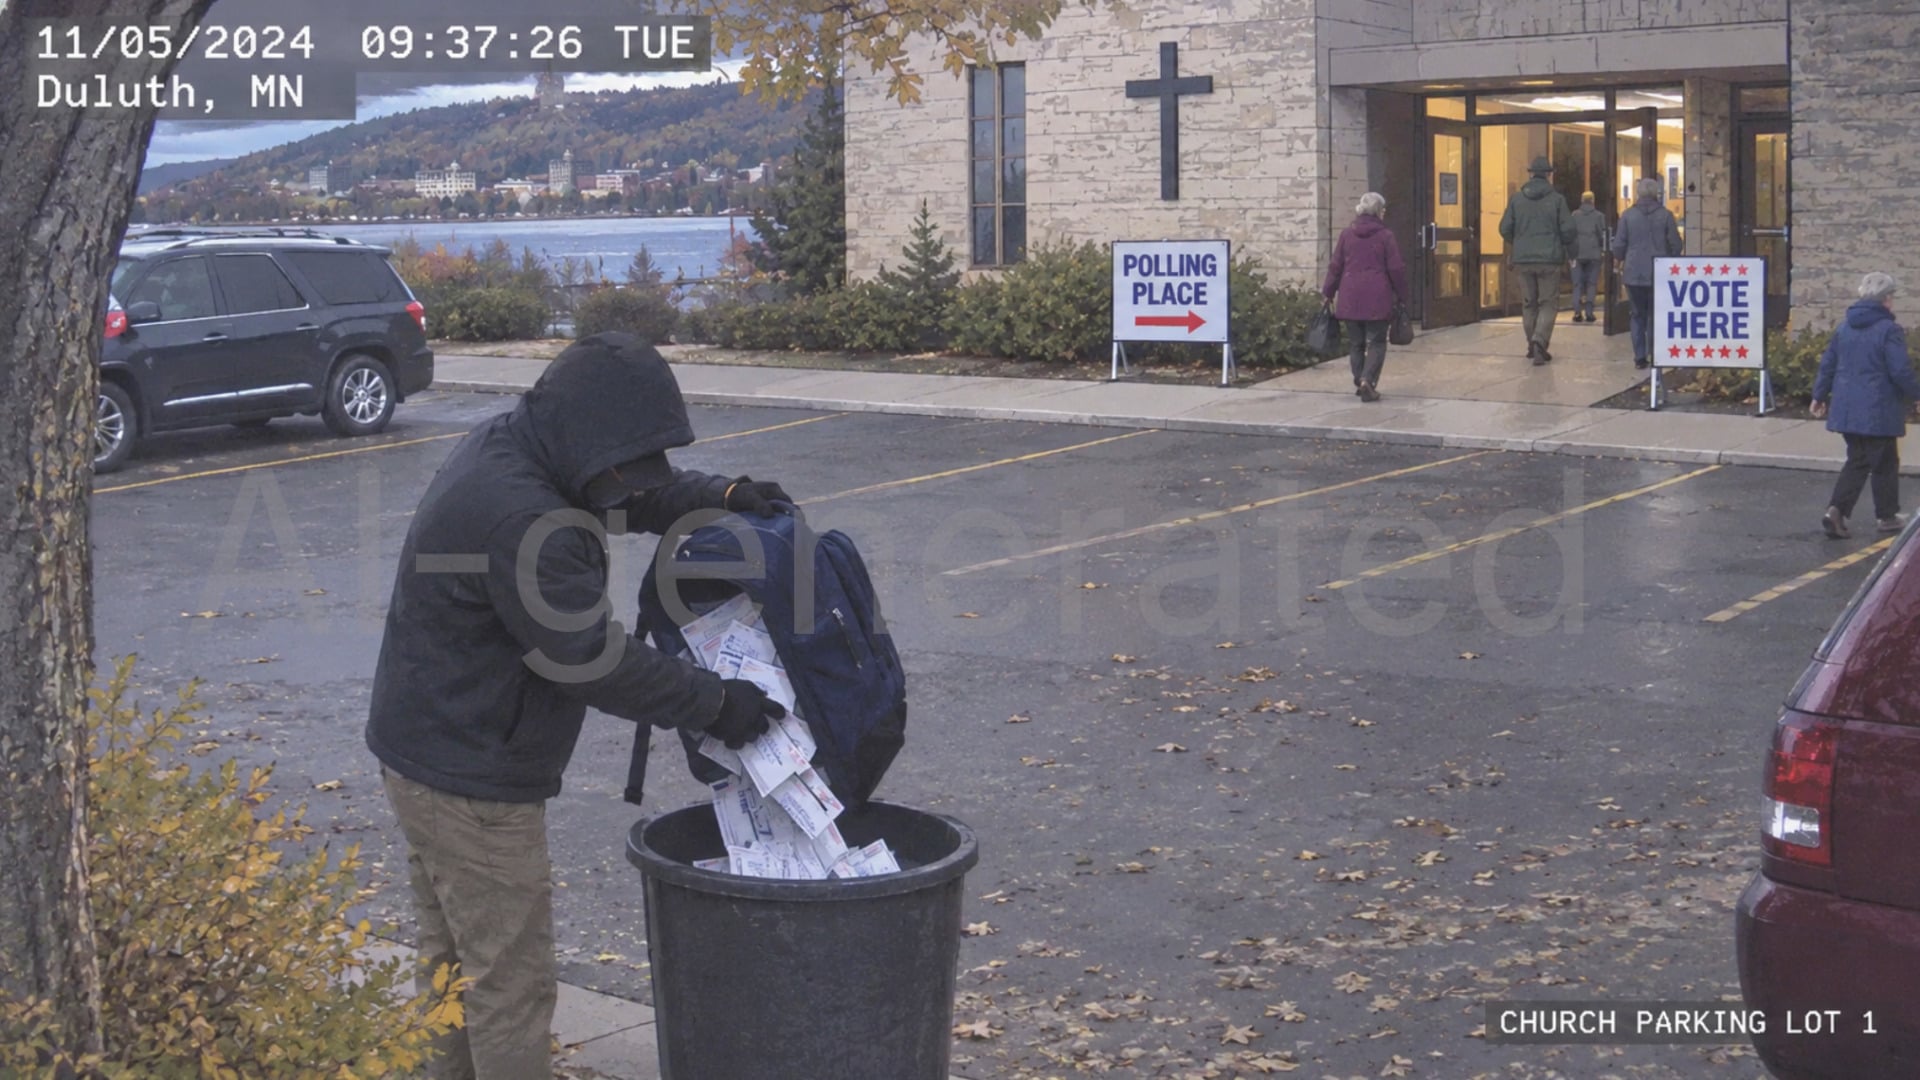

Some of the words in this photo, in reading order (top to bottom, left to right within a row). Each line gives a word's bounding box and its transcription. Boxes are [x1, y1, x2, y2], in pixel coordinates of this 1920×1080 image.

[1123, 253, 1217, 277] POLLING
[1132, 282, 1208, 305] PLACE
[1667, 280, 1749, 308] VOTE
[1667, 312, 1749, 339] HERE
